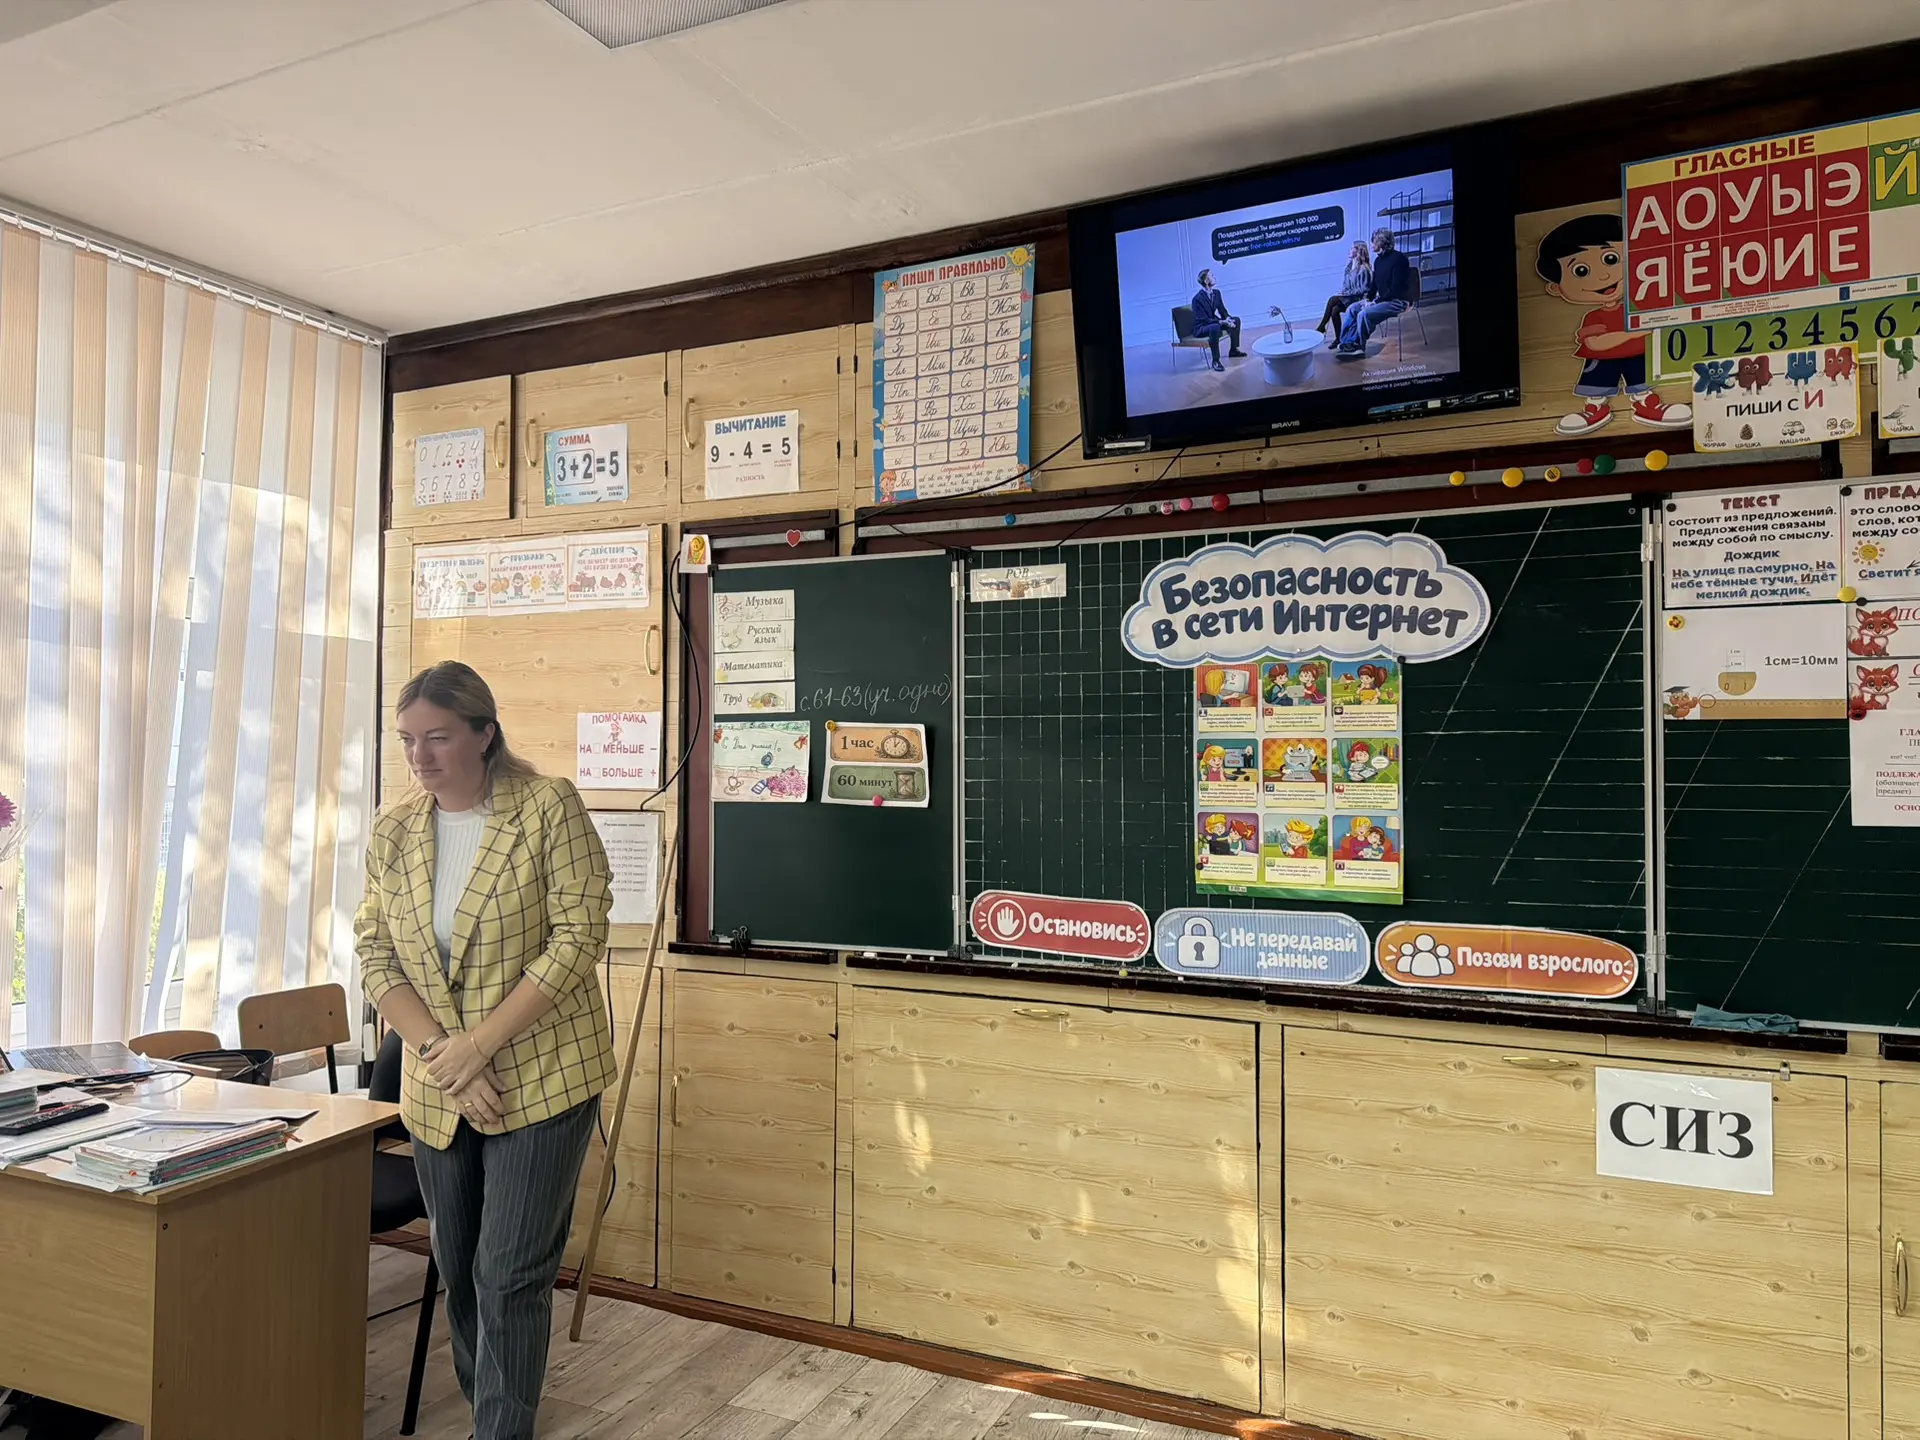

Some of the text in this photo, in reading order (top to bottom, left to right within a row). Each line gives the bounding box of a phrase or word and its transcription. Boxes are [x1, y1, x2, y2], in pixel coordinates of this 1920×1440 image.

[1674, 135, 1815, 177] ГЛАСНЫЕ
[1875, 144, 1917, 201] Й
[1630, 162, 1861, 240] А О У Ы Э
[1269, 220, 1294, 231] выиграл
[1218, 221, 1337, 248] игровых монет! Забери скорее подарок
[1228, 246, 1250, 254] ссылке:
[902, 257, 1006, 286] ПИШИ ПРАВИЛЬНО
[1635, 226, 1859, 302] Я Ё Ю И Е
[1668, 303, 1896, 362] 0 1 2 3 4 5 6
[1398, 364, 1426, 372] Windows
[1727, 399, 1782, 417] ПИШИ
[1805, 389, 1823, 409] И
[715, 415, 786, 434] ВЫЧИТАНИЕ
[1271, 420, 1300, 429] BRAVIS
[558, 434, 590, 446] СУММА
[1779, 436, 1811, 445] МАШИНА
[711, 446, 719, 462] 9
[744, 441, 752, 459] 4
[782, 437, 790, 455] 5
[1721, 494, 1780, 510] ТЕКСТ
[1669, 506, 1836, 526] состоит из предложений.
[1680, 520, 1825, 537] Предложения связаны
[1853, 529, 1898, 538] между
[1673, 530, 1833, 548] между собой по смыслу.
[1724, 549, 1779, 562] Дождик
[1672, 561, 1835, 580] На улице пасмурно. На
[1858, 569, 1911, 579] Светит
[1671, 572, 1837, 589] небе тёмные тучи. Идёт
[1160, 567, 1443, 615] Безопасность
[1696, 586, 1810, 599] мелкий дождик.
[746, 596, 784, 609] Музыка
[1184, 606, 1264, 640] сети
[1273, 599, 1468, 641] Интернет
[747, 625, 781, 637] Русский
[724, 662, 783, 671] Математика
[1765, 656, 1838, 666] 1см=10мм
[723, 693, 743, 706] Труд
[592, 713, 647, 724] ПОМОГАЙКА
[580, 744, 644, 753] НА МЕНЬШЕ
[841, 735, 874, 749] 1 час
[580, 768, 643, 777] НА БОЛЬШЕ
[837, 775, 893, 788] 60 минут
[1029, 911, 1137, 942] Остановись
[1230, 927, 1358, 954] Не передавай
[1257, 950, 1329, 970] данные
[1457, 946, 1623, 976] Позови взрослого
[1609, 1101, 1754, 1159] СИЗ
